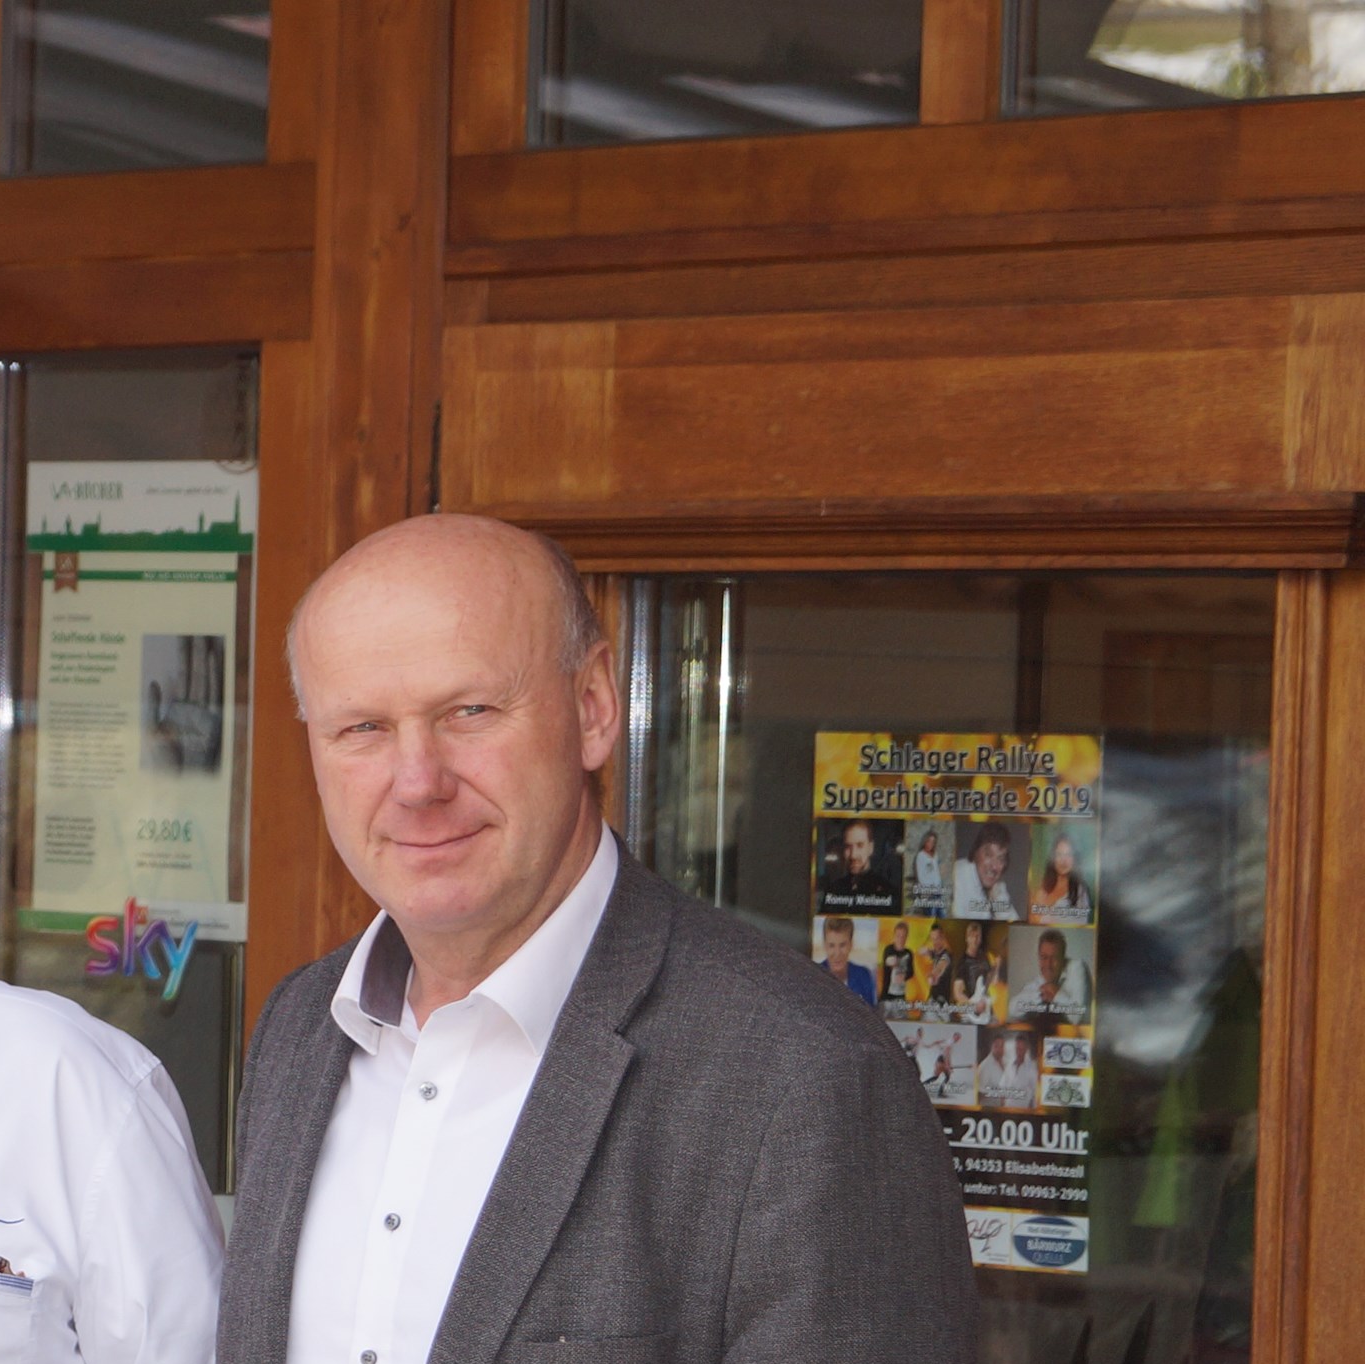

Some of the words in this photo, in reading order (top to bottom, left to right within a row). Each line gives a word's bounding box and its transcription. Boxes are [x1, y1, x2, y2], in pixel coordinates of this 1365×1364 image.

[860, 744, 968, 772] Schlager
[976, 745, 1055, 776] Rallye
[823, 783, 1017, 813] Superhitparade
[1028, 786, 1091, 813] 2019
[85, 896, 198, 1000] sky
[961, 1117, 1033, 1146] 20.00
[1041, 1122, 1089, 1151] Uhr
[965, 1158, 1002, 1173] 94353
[1005, 1161, 1085, 1178] Elisabethszell
